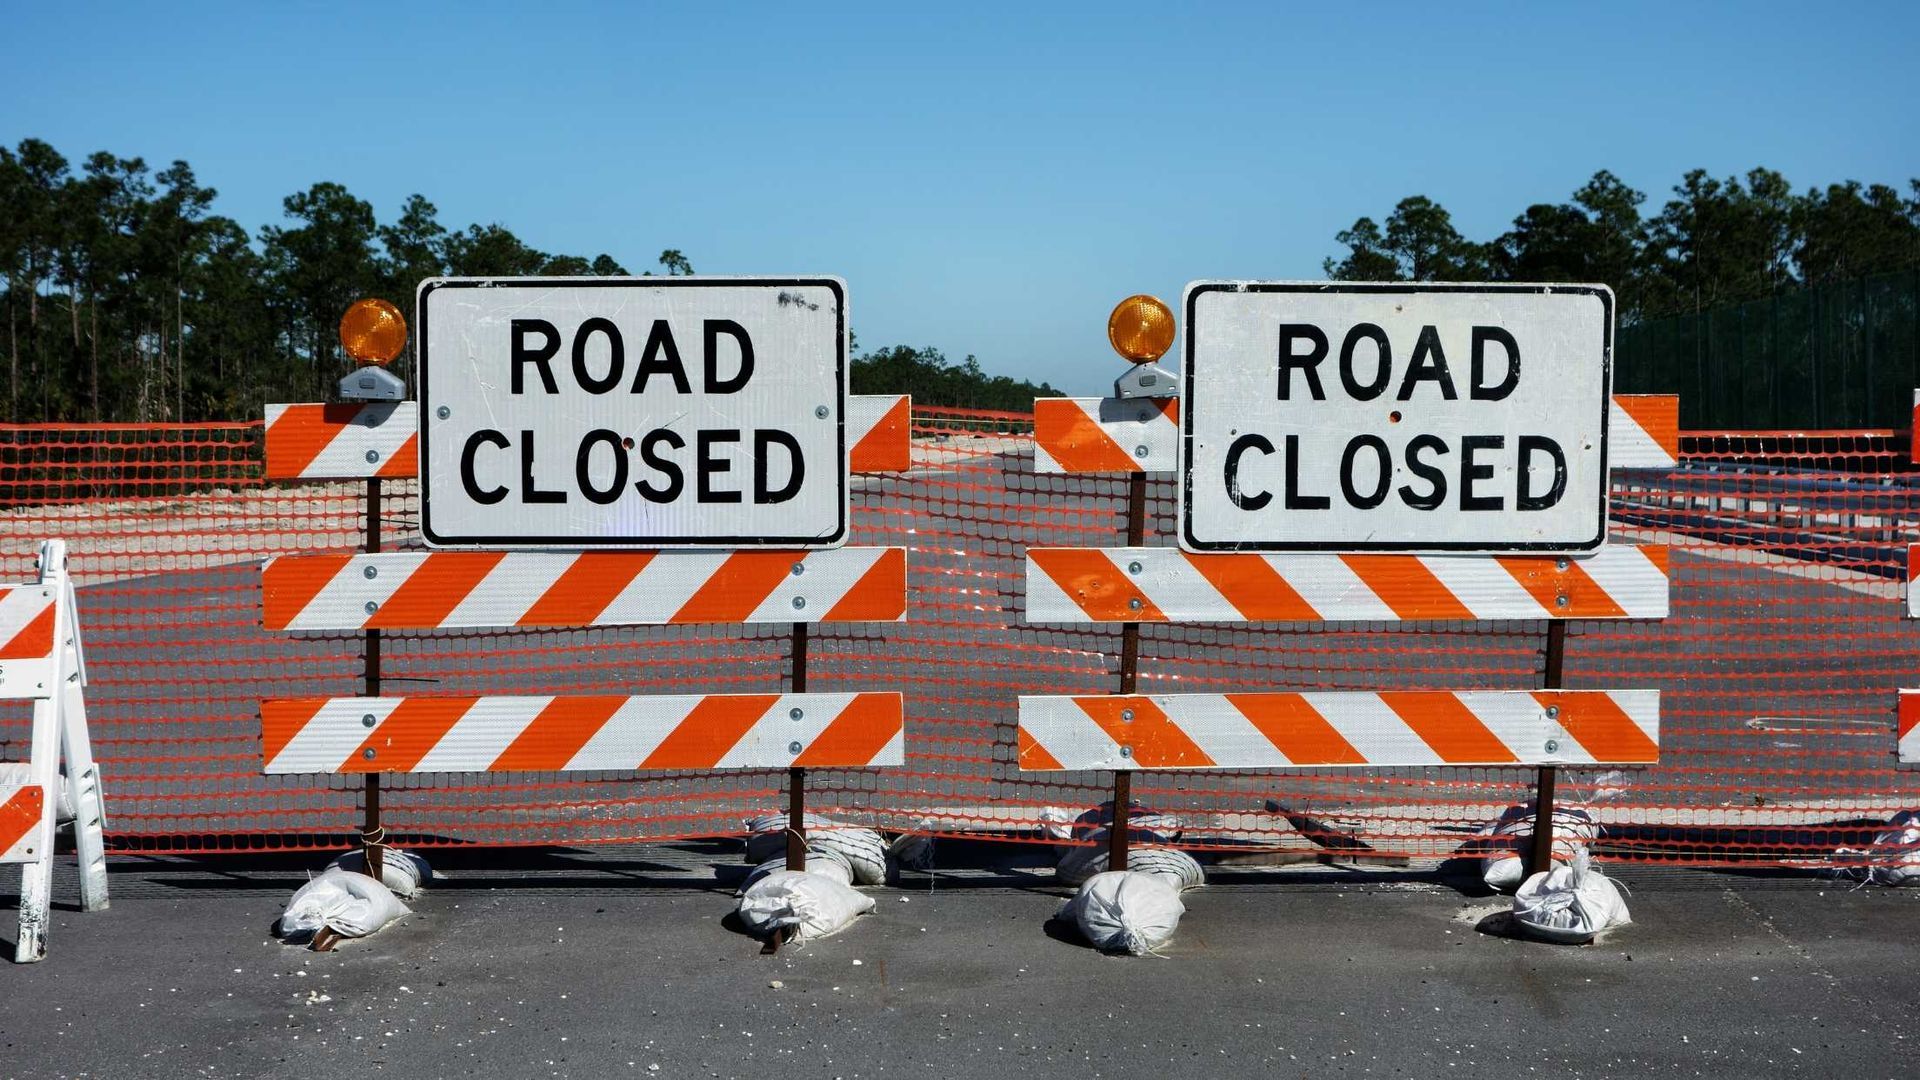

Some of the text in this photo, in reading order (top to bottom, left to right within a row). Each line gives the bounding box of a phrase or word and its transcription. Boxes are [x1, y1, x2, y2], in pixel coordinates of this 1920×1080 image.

[510, 317, 755, 395] ROAD
[1277, 322, 1521, 402] ROAD
[460, 428, 805, 506] CLOSED
[1223, 433, 1568, 512] CLOSED
